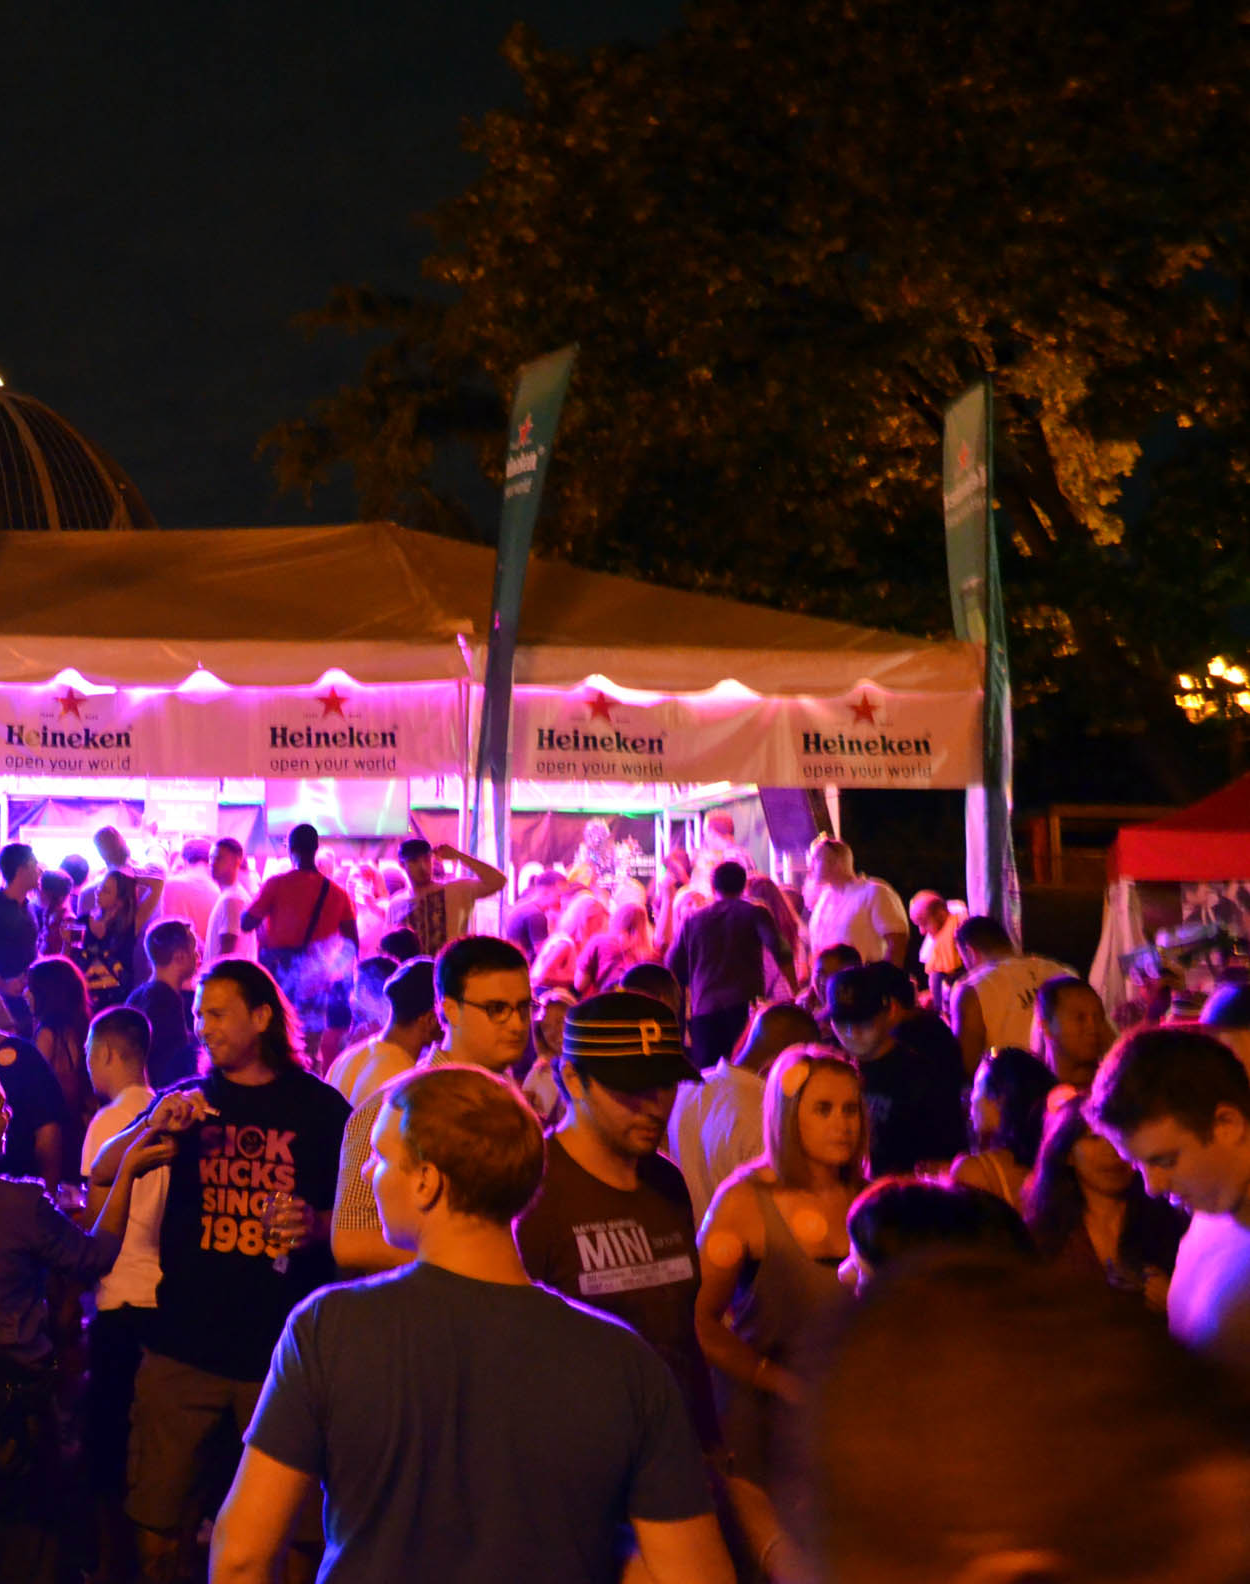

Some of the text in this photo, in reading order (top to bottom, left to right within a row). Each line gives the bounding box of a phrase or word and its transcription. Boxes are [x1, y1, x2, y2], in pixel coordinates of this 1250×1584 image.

[5, 724, 131, 749] Heineken
[269, 726, 397, 749] Heineken
[537, 728, 664, 755] Heineken
[802, 732, 931, 756] Heineken
[5, 755, 131, 772] open your world
[270, 756, 396, 773] open your world
[536, 760, 663, 777] open your world
[803, 762, 932, 778] open your world
[638, 1019, 661, 1056] P
[199, 1157, 295, 1192] KICKS
[202, 1186, 270, 1217] SINC
[574, 1224, 653, 1272] MINI
